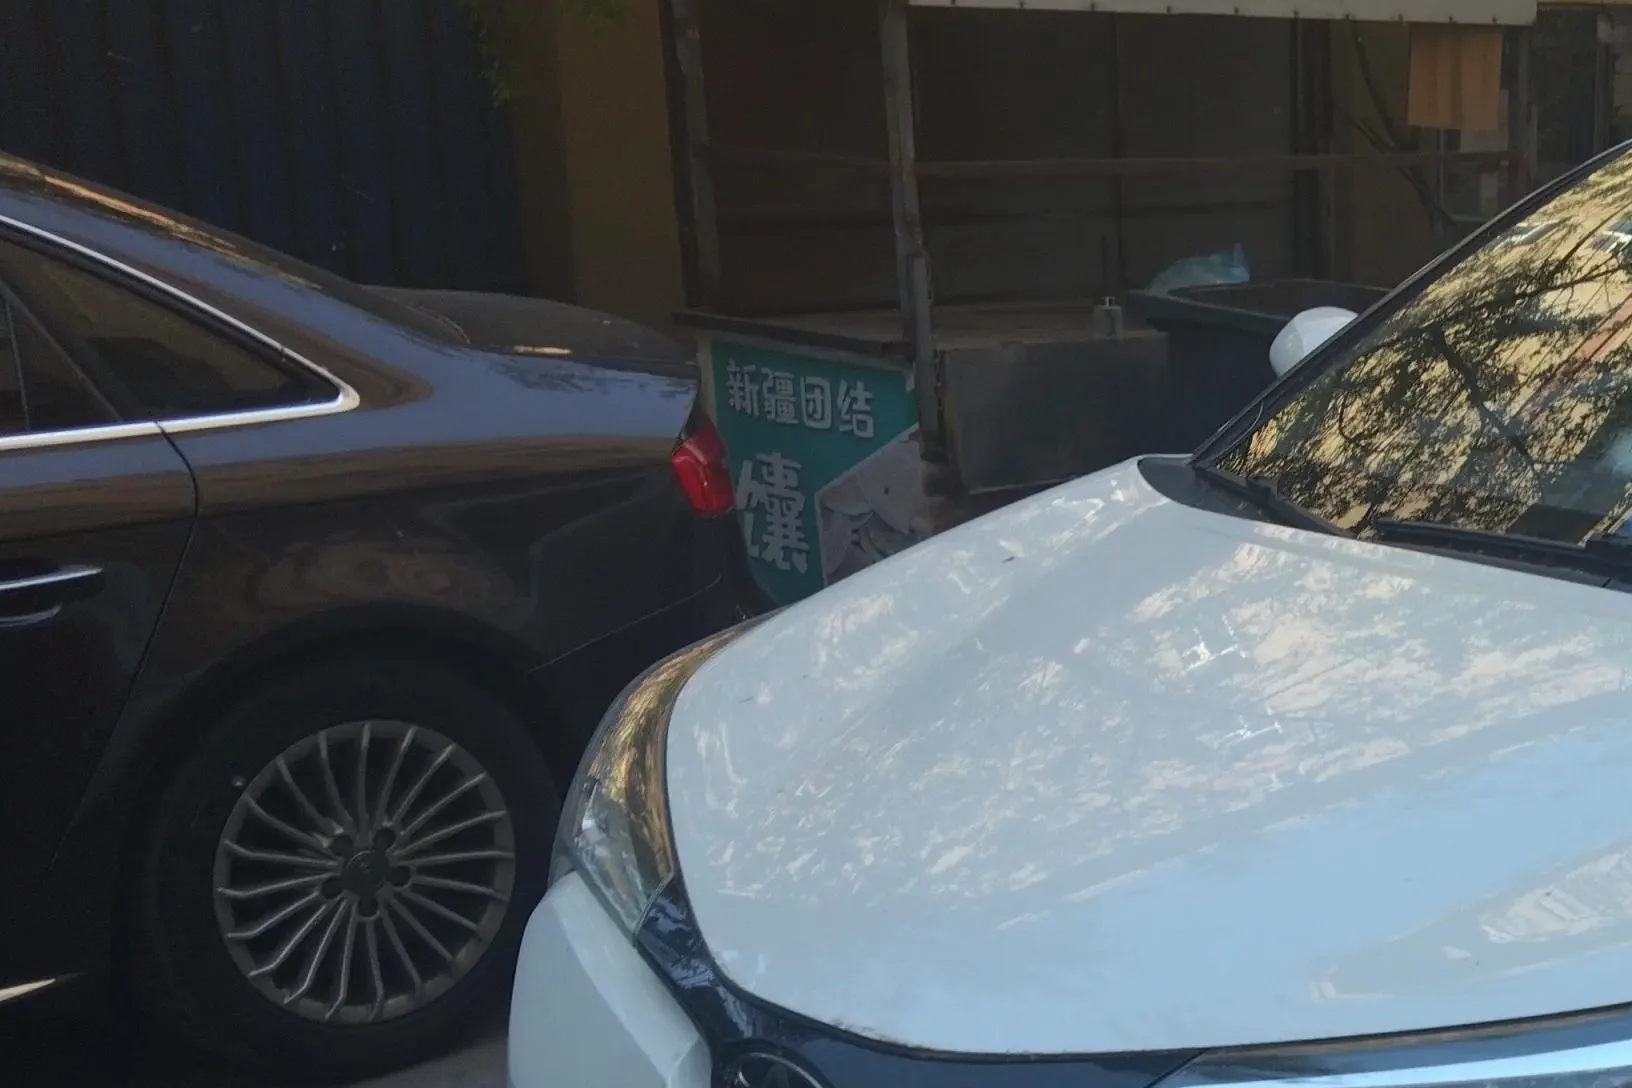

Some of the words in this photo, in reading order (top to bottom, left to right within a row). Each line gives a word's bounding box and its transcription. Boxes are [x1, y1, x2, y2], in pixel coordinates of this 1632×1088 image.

[726, 357, 875, 438] 新疆团结
[735, 452, 810, 574] 馕
